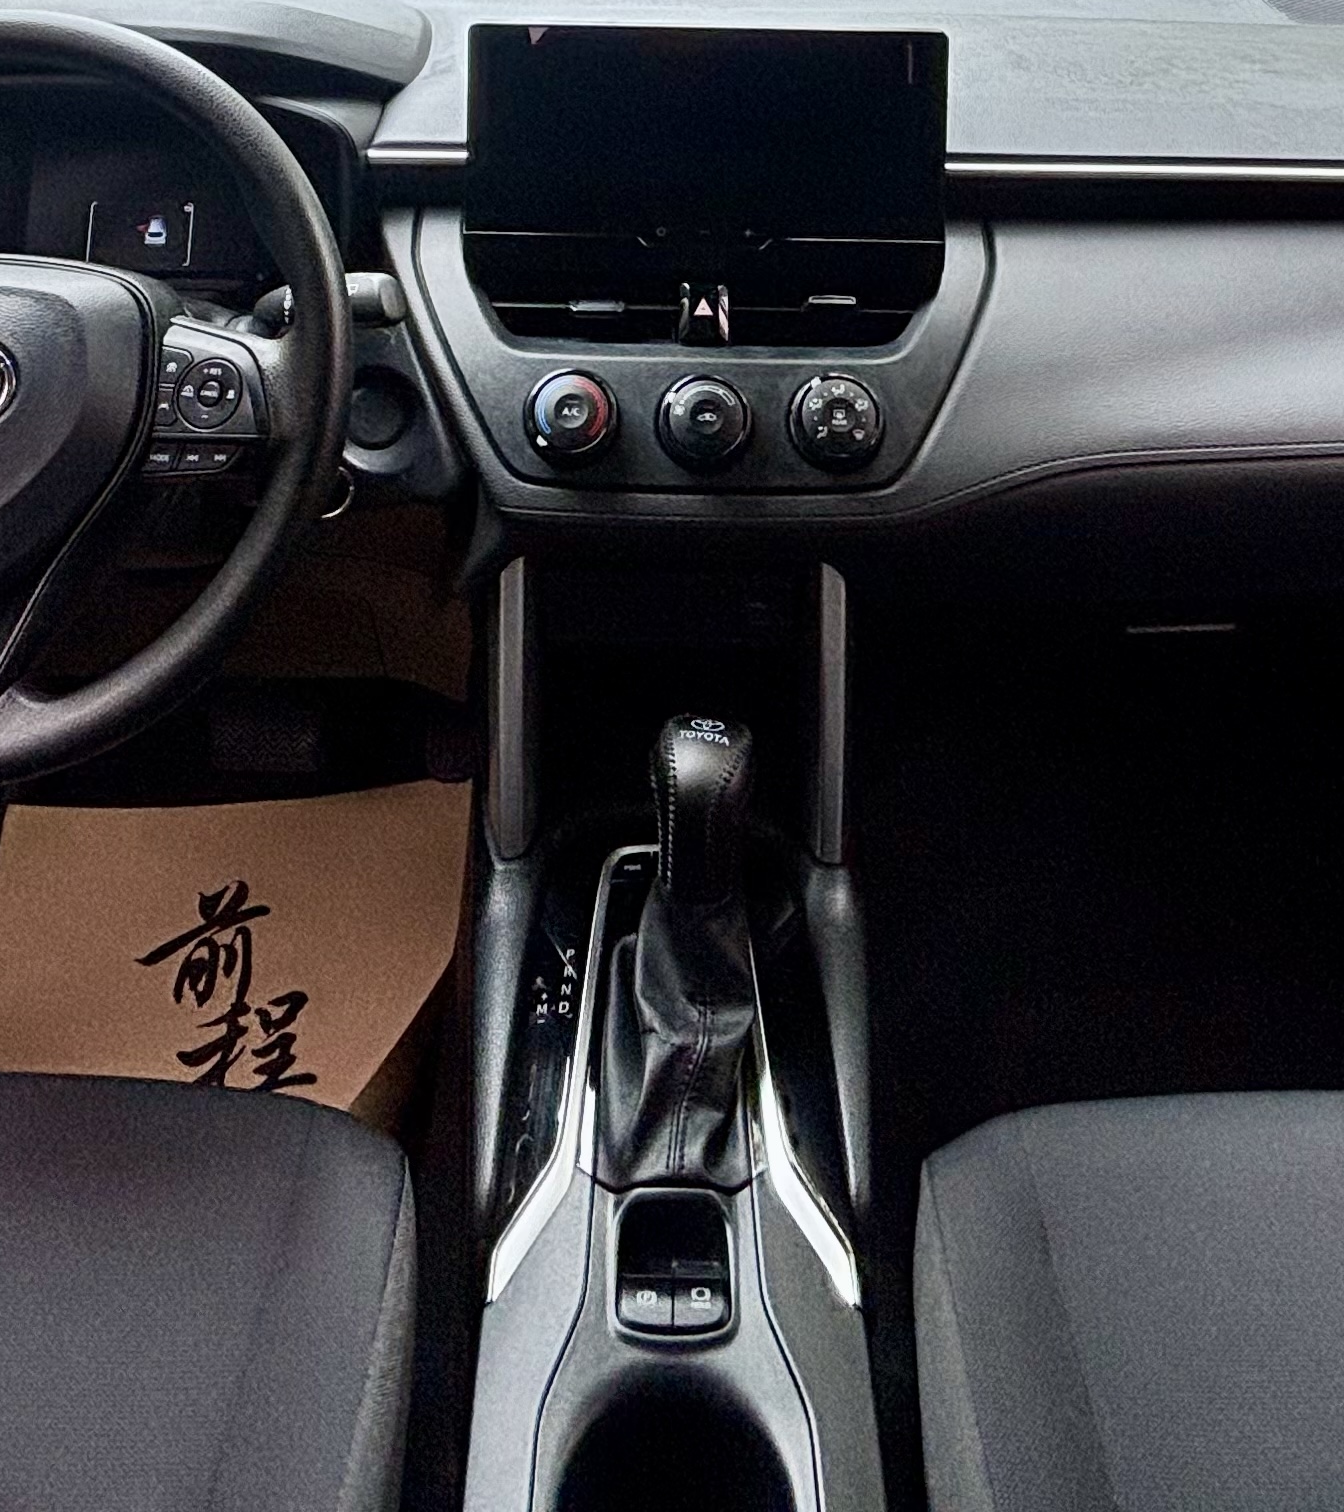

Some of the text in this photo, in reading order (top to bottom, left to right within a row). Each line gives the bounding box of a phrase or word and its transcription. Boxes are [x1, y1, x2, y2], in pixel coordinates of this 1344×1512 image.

[561, 406, 582, 418] A/C
[678, 729, 730, 747] TOYOTA
[134, 880, 318, 1092] 前程
[560, 983, 572, 996] N
[536, 1003, 548, 1016] M
[558, 1001, 570, 1014] D
